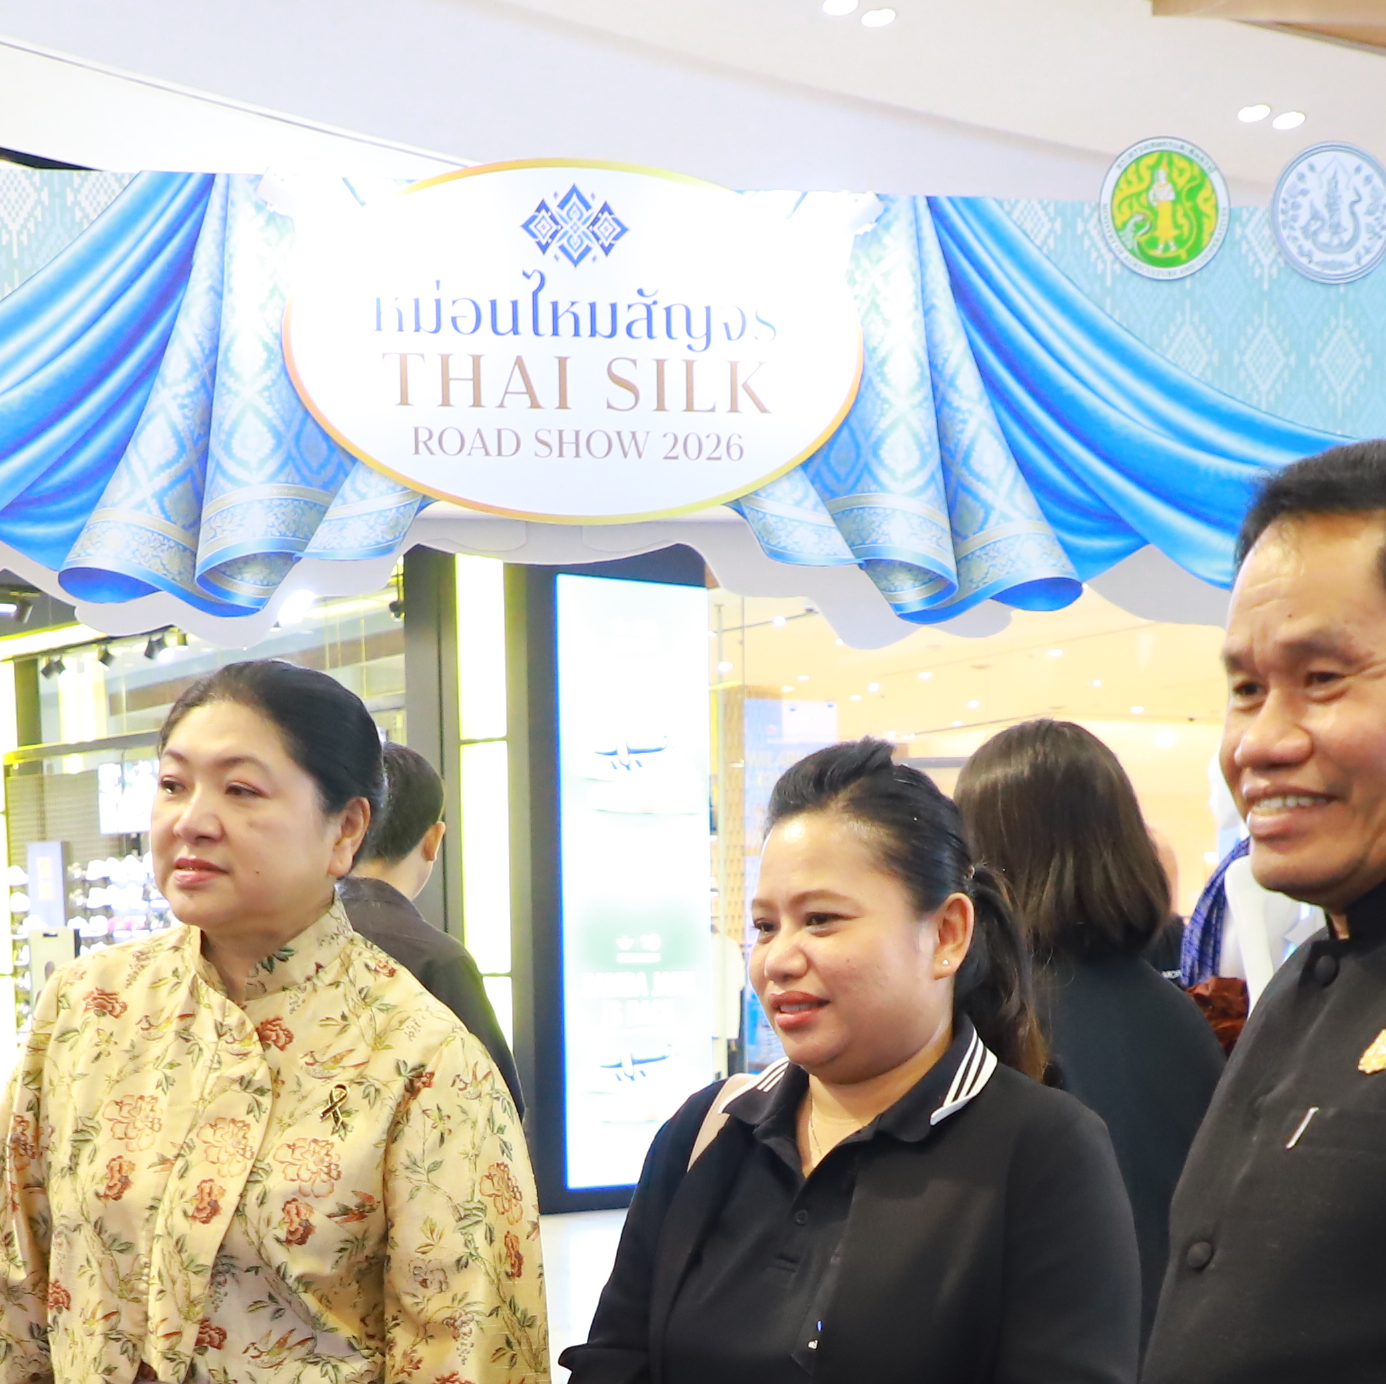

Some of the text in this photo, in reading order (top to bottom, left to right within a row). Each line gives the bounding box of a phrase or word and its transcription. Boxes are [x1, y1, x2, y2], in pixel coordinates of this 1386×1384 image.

[374, 268, 778, 353] หม่อนไหมสัญจร
[381, 351, 773, 416] THAI SILK
[411, 425, 745, 463] ROAD SHOW 2026
